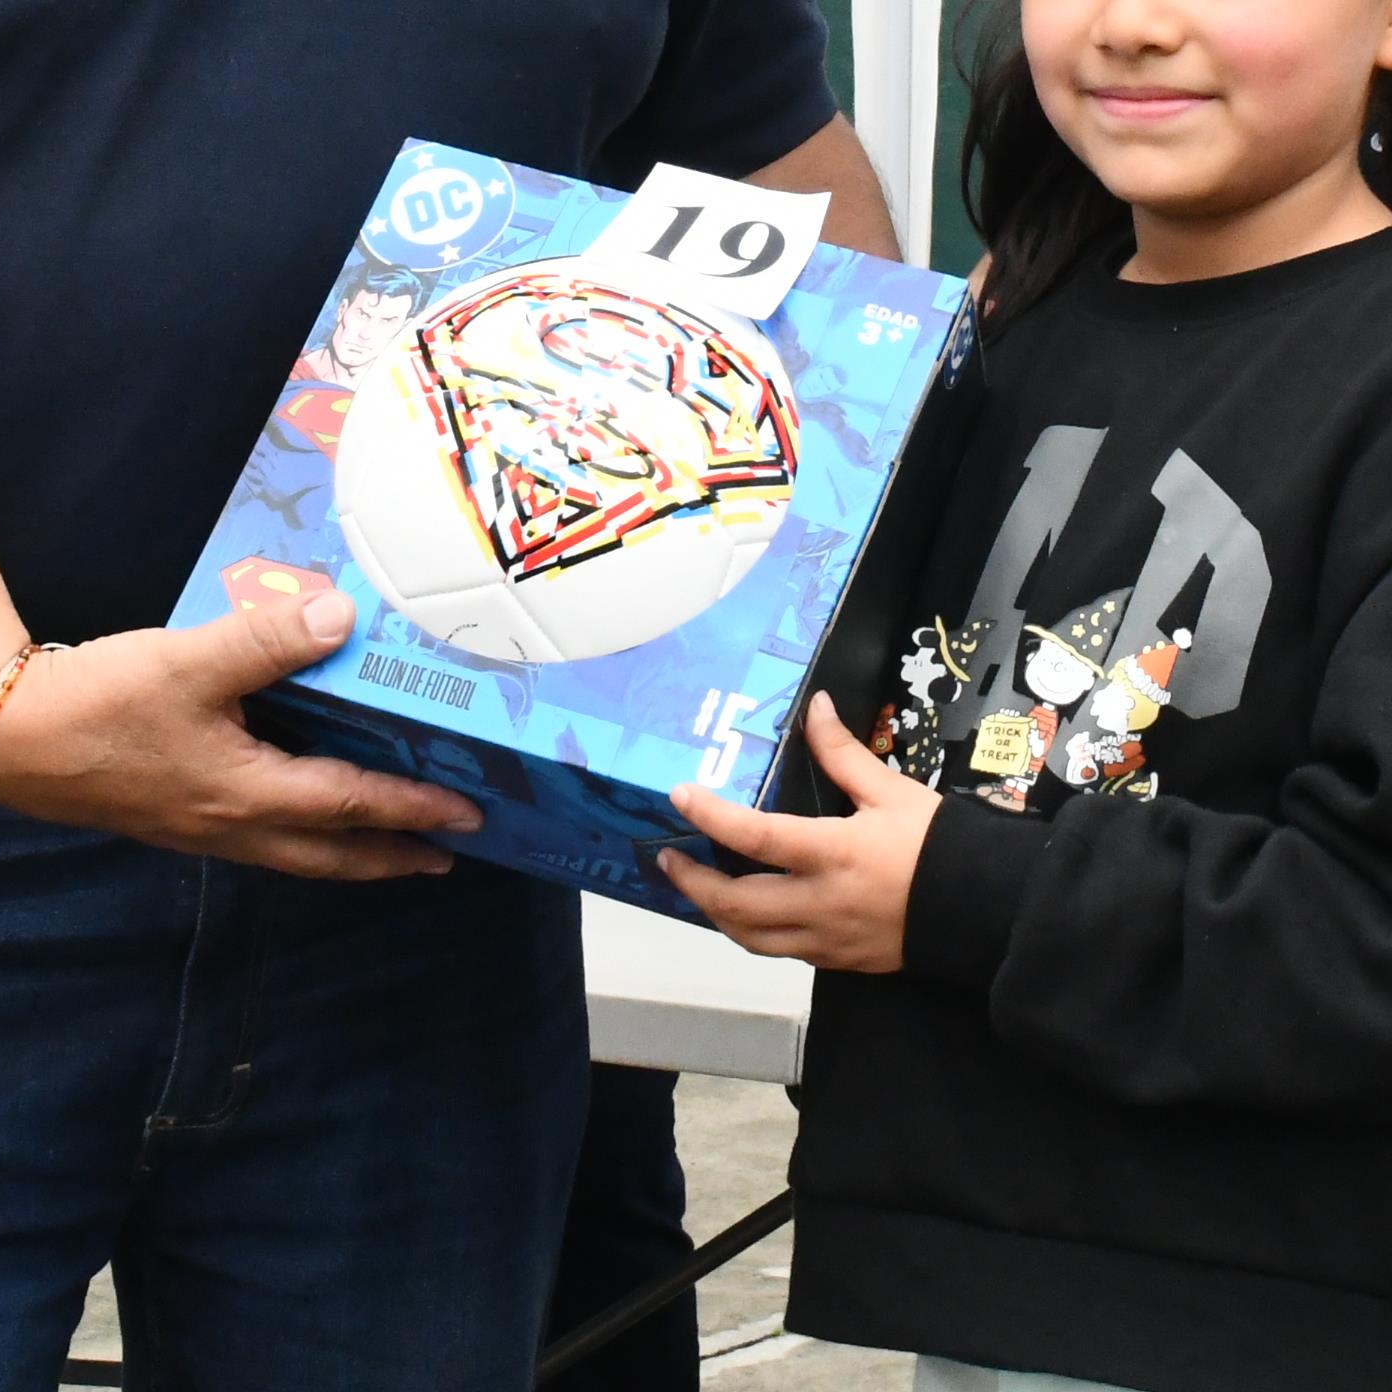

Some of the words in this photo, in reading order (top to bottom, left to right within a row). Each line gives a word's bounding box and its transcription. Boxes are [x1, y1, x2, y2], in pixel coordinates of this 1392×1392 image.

[404, 180, 474, 233] DC
[639, 206, 786, 277] 19
[864, 303, 918, 330] EDAD
[358, 651, 409, 690] BALÓN
[403, 664, 427, 695] DE
[422, 669, 477, 711] FÚTBOL
[692, 688, 758, 788] #5
[986, 727, 1021, 738] TRICK
[996, 739, 1010, 747] OR
[981, 749, 1018, 761] TREAT
